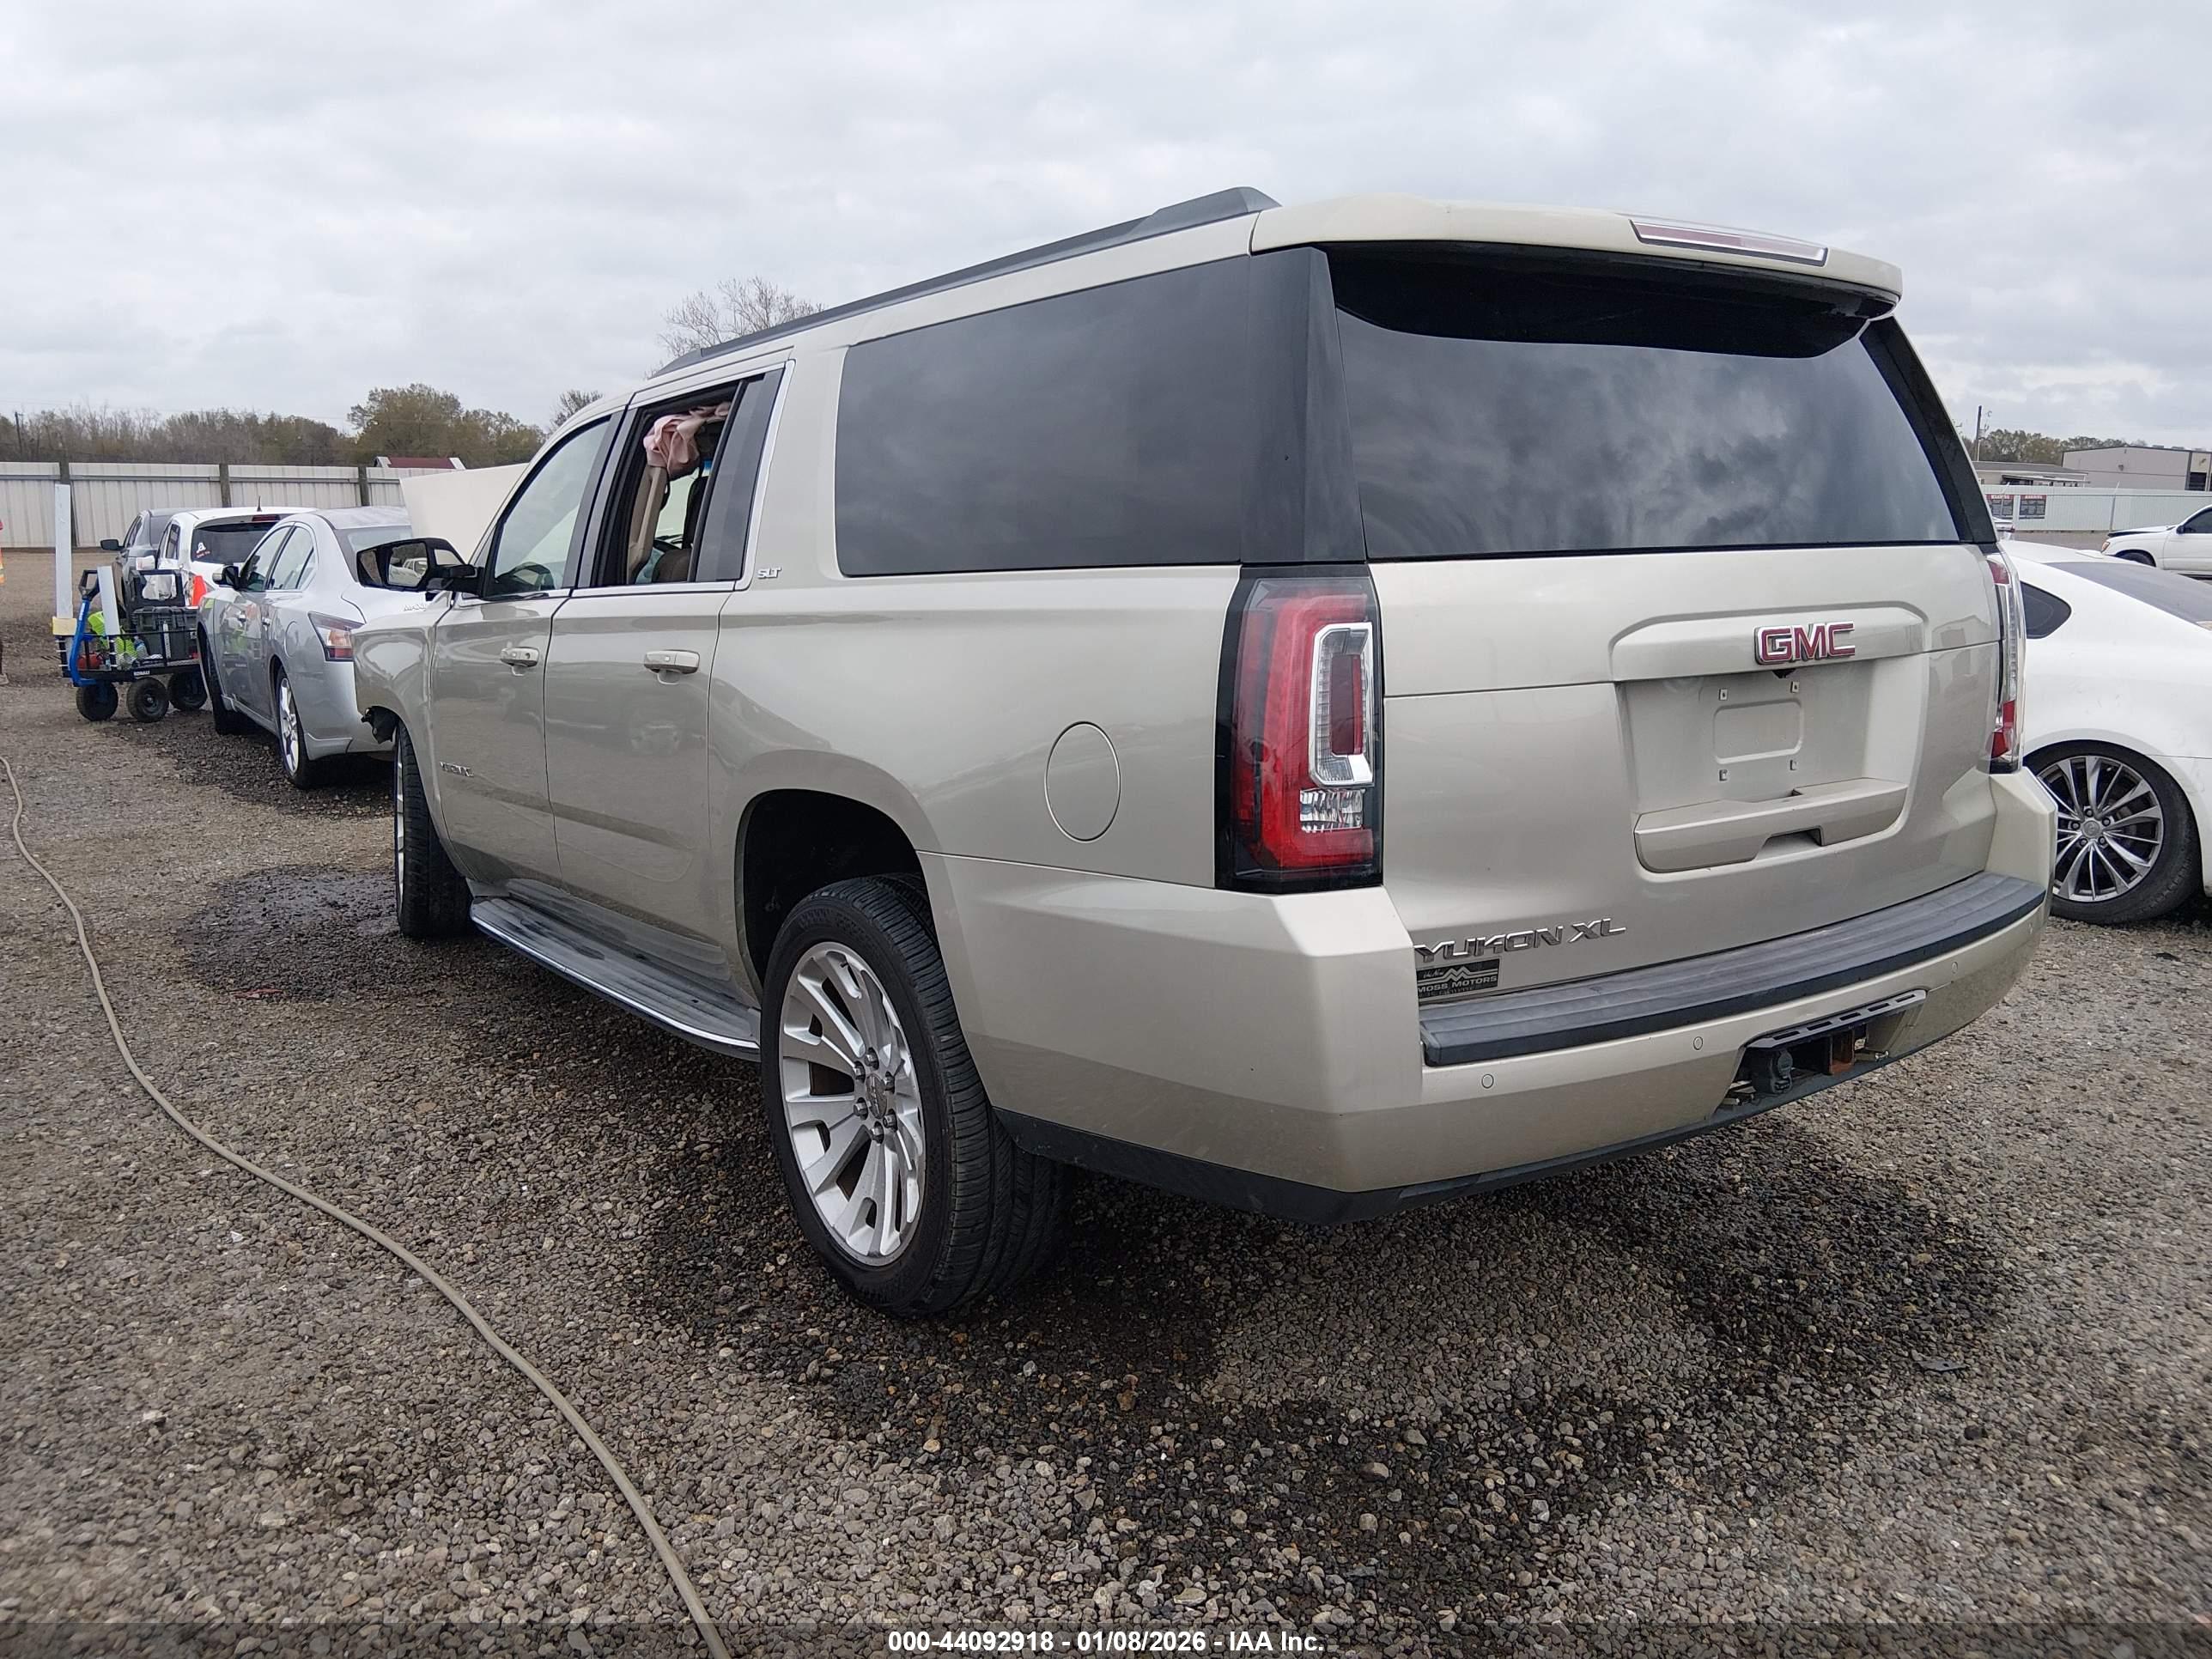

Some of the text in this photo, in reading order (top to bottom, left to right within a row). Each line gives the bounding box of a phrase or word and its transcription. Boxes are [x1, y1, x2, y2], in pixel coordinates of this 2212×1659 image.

[1753, 621, 1856, 665] GMC
[1413, 918, 1627, 963] YUKON XL
[1418, 982, 1449, 993] MOSS
[1451, 975, 1498, 988] MOTORS
